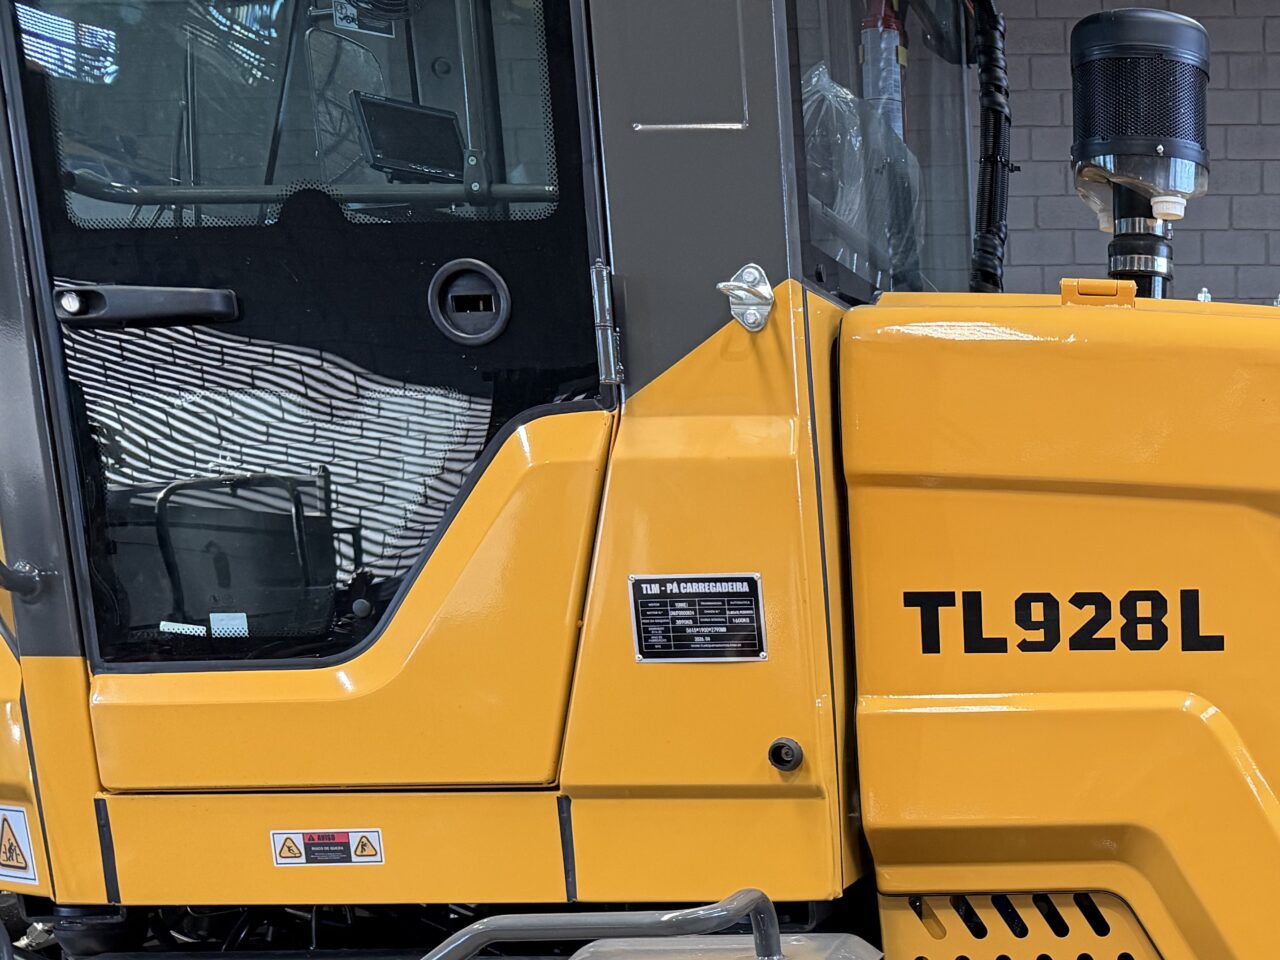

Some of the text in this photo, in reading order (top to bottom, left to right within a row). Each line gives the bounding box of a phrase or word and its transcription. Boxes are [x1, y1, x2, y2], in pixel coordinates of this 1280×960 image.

[641, 583, 660, 594] TLM
[666, 581, 679, 594] PÁ
[680, 582, 750, 594] CARREGADEIRA
[903, 588, 1226, 656] TL928L
